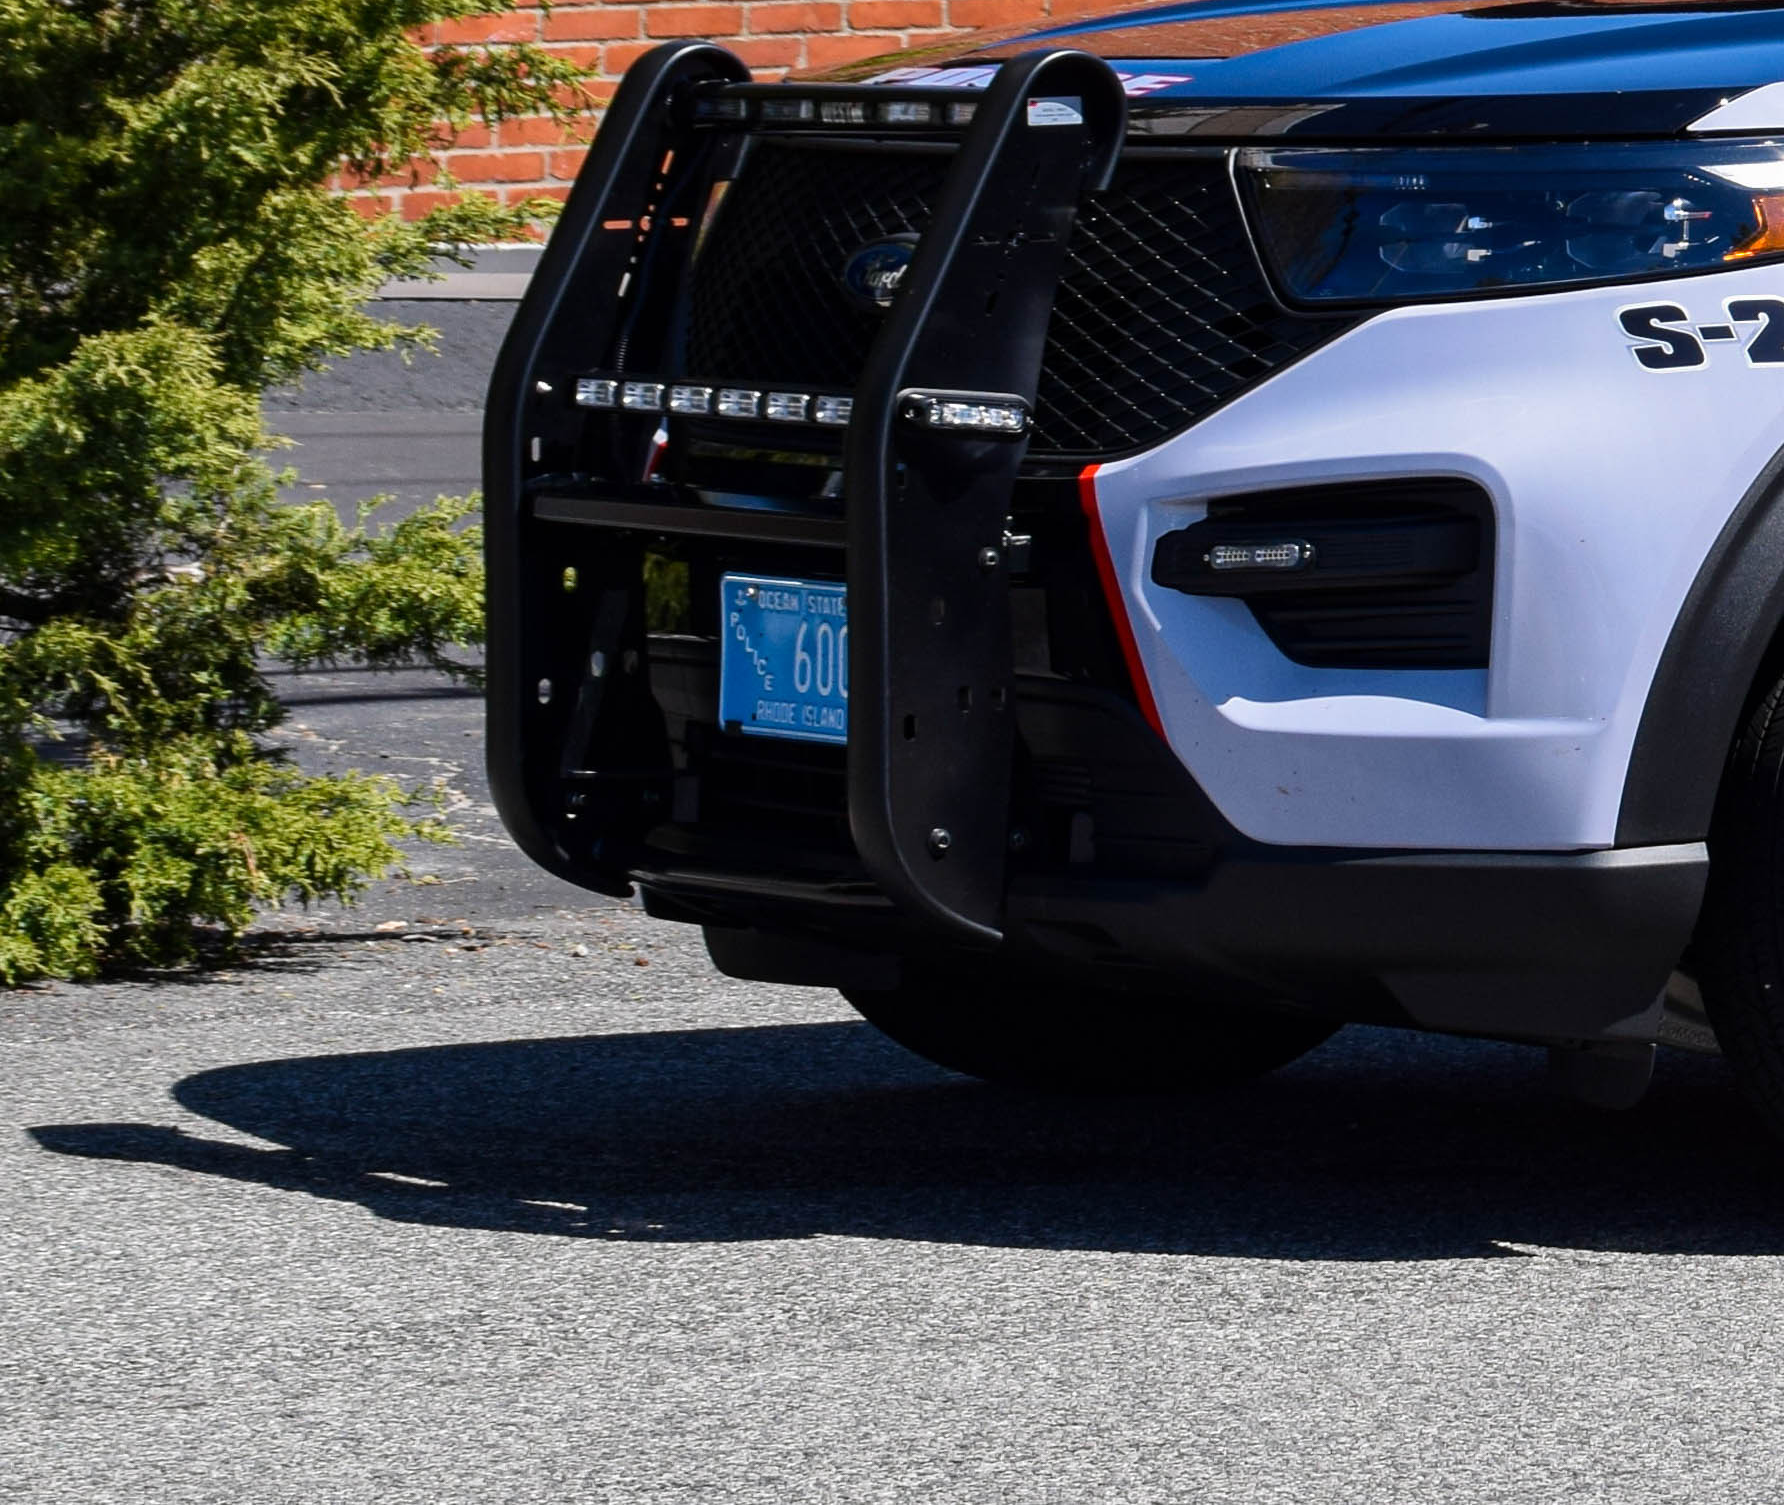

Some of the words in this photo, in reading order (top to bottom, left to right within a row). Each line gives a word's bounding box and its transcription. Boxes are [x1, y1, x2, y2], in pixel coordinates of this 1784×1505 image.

[758, 589, 800, 611] OCEAN
[808, 595, 848, 617] STATE
[730, 611, 775, 692] POLICE
[756, 700, 797, 724] RHODE
[803, 706, 845, 730] ISLAND
